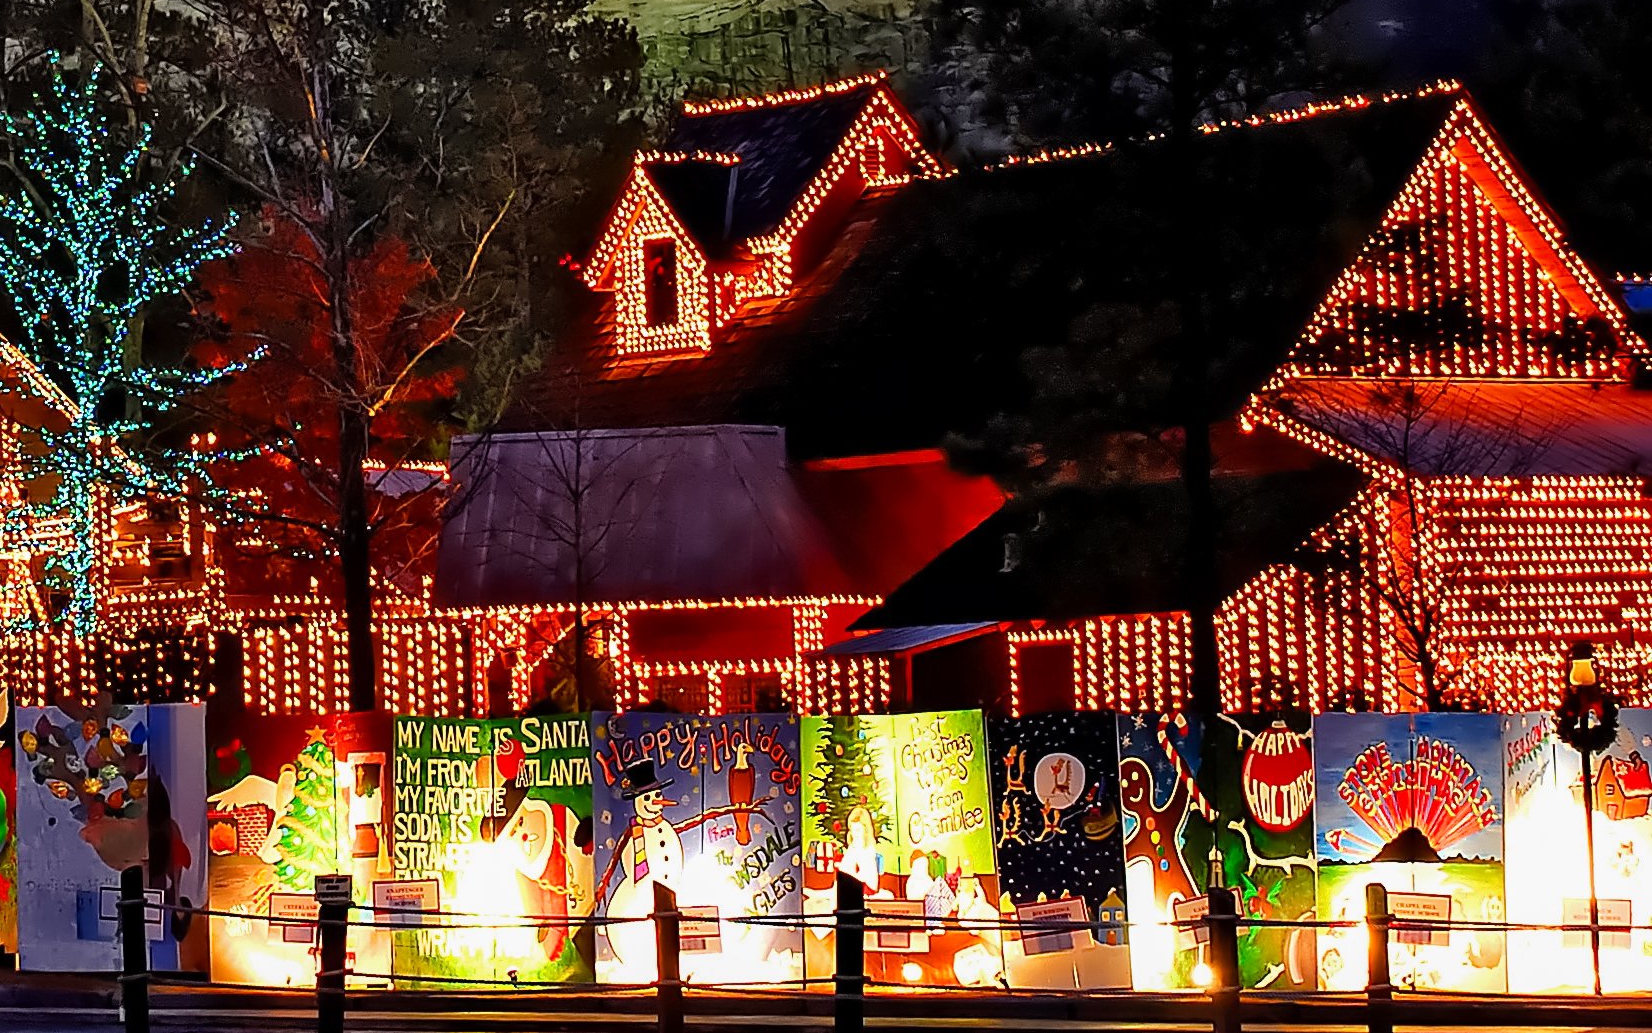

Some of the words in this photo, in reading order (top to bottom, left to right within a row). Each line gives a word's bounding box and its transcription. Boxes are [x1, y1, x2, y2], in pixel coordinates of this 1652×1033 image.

[397, 720, 424, 749] MY
[432, 725, 480, 753] NAME
[493, 727, 514, 755] IS
[520, 718, 590, 754] SANTA
[902, 733, 974, 771] Christmas
[1251, 731, 1301, 756] HAPPY
[396, 752, 421, 784] I'M
[427, 759, 478, 788] FROM
[515, 757, 594, 788] ATLANTA
[595, 723, 698, 786] Happy
[710, 718, 801, 797] Holidays
[395, 786, 422, 813] MY
[1244, 768, 1315, 827] HOLIDAYS
[1337, 741, 1393, 807] STONE
[1417, 735, 1499, 829] MOUNTAIN
[394, 812, 443, 842] SODA
[449, 815, 473, 842] IS
